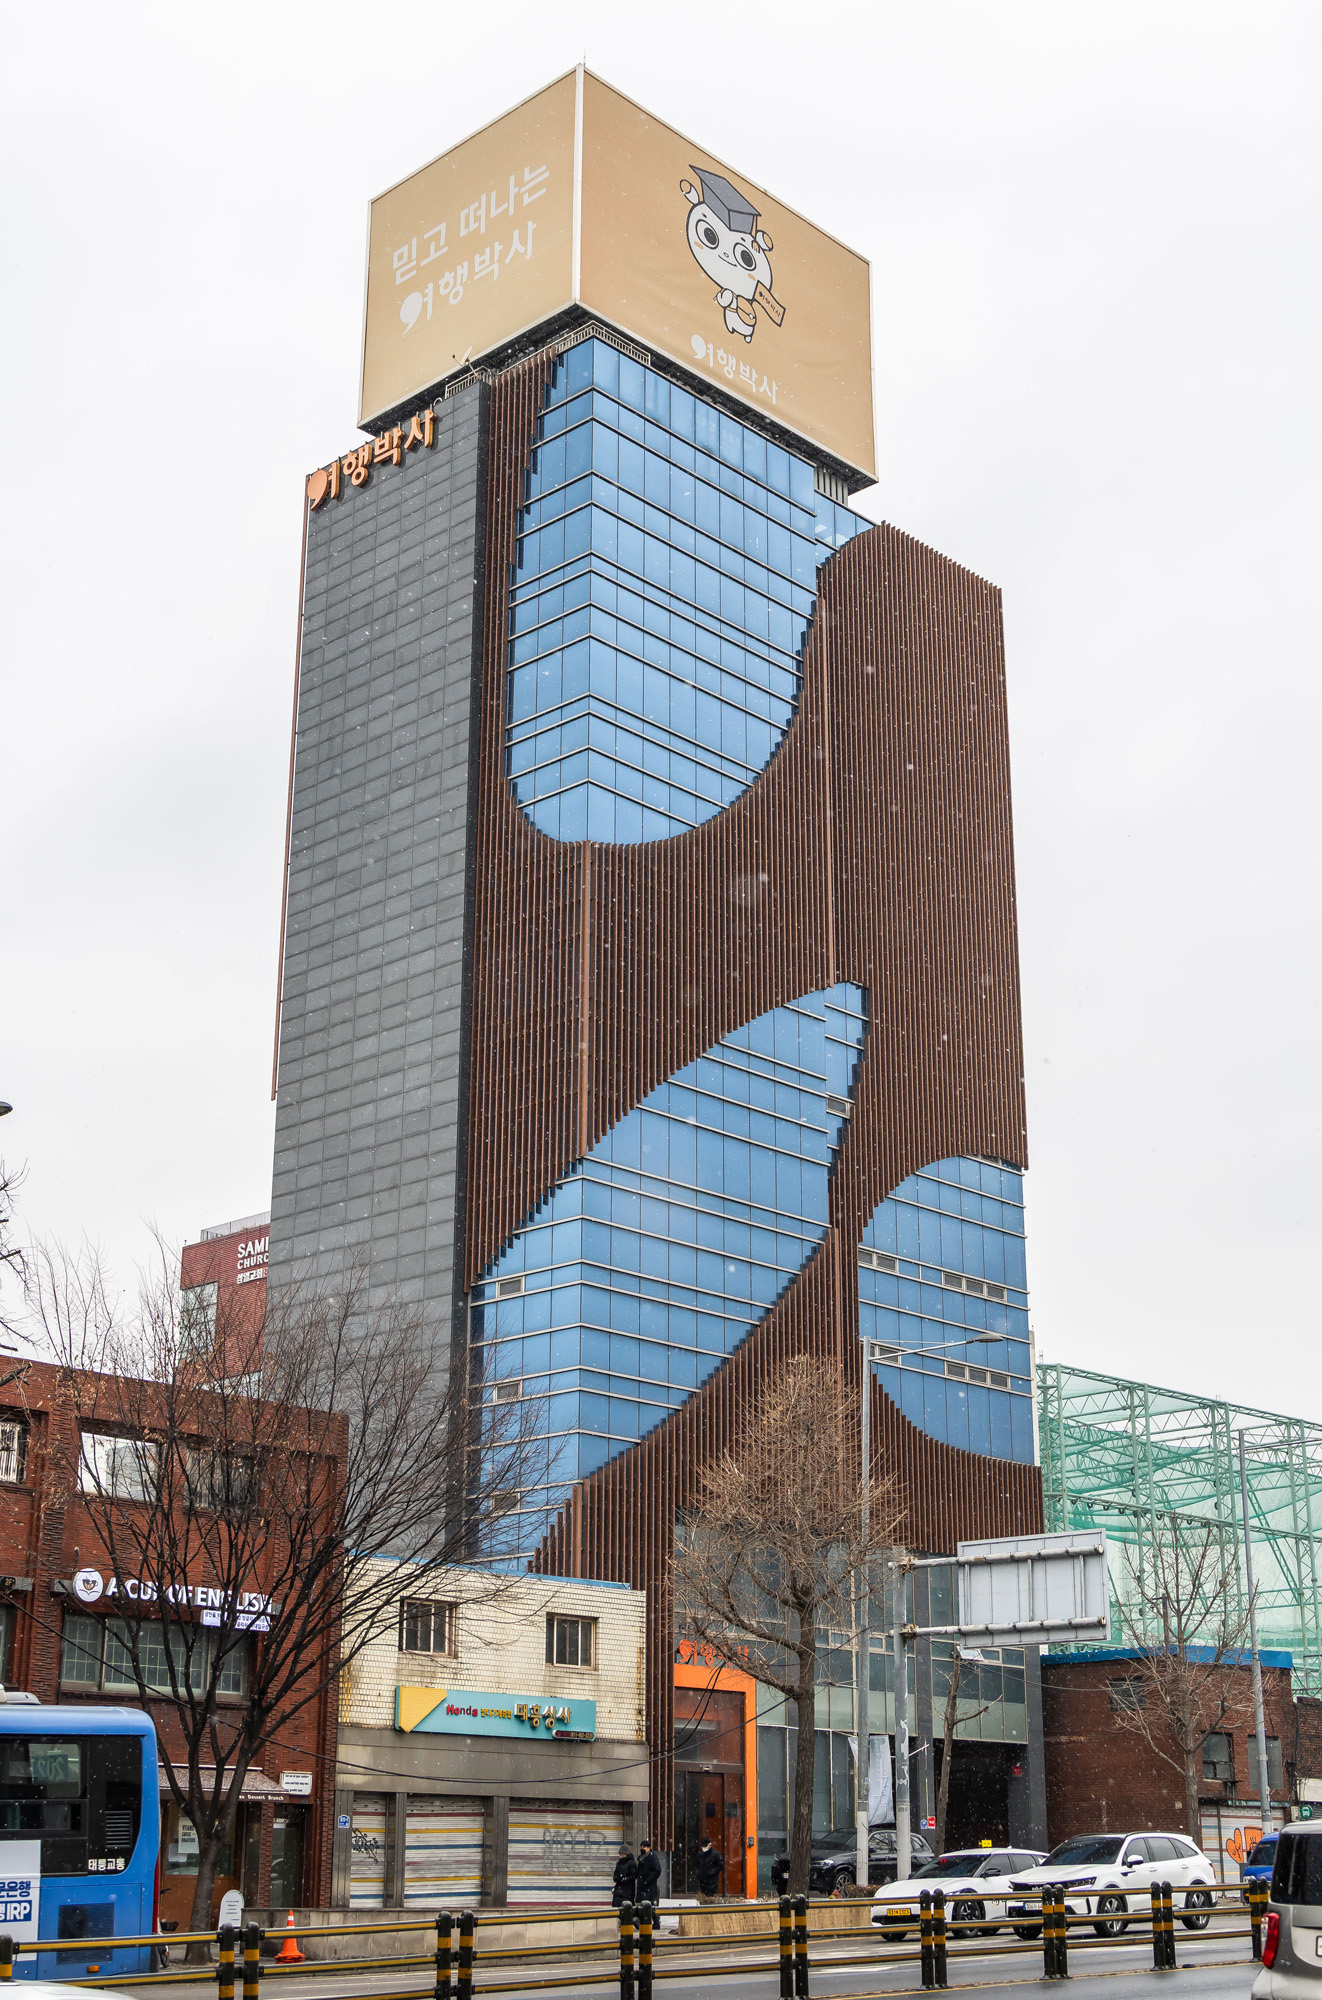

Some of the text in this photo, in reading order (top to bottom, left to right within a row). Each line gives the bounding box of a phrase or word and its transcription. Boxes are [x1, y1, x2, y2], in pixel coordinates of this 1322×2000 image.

[392, 164, 550, 286] 믿고 떠나는
[400, 220, 537, 335] 여행박사
[690, 334, 778, 405] 여행박사
[306, 408, 437, 512] 여행박사
[237, 1253, 269, 1270] CHURC
[125, 1579, 165, 1601] CU
[446, 1704, 478, 1717] Honda
[514, 1704, 572, 1729] 대흥상사
[88, 1858, 126, 1871] 태릉교통
